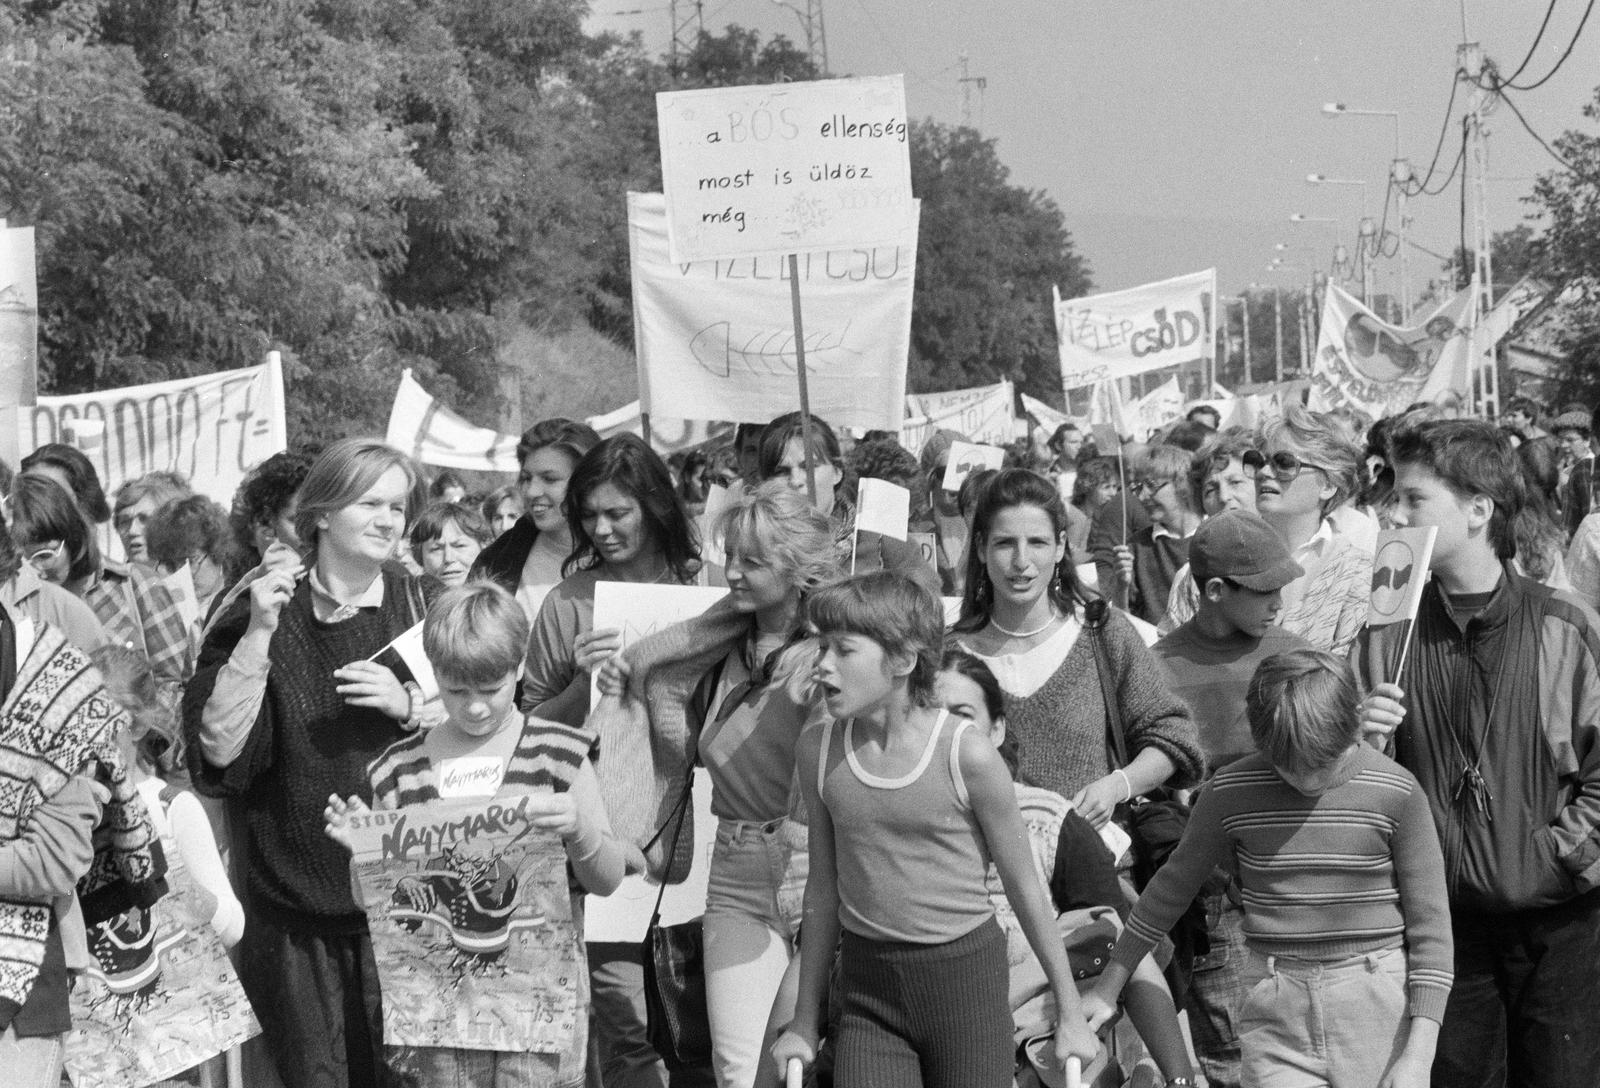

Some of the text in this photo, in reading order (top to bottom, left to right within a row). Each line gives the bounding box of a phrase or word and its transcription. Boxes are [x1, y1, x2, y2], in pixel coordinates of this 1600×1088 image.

[820, 113, 907, 143] ellenség
[698, 163, 873, 191] most is üldöz
[350, 812, 399, 829] STOP
[382, 796, 533, 860] NAGYMAROS
